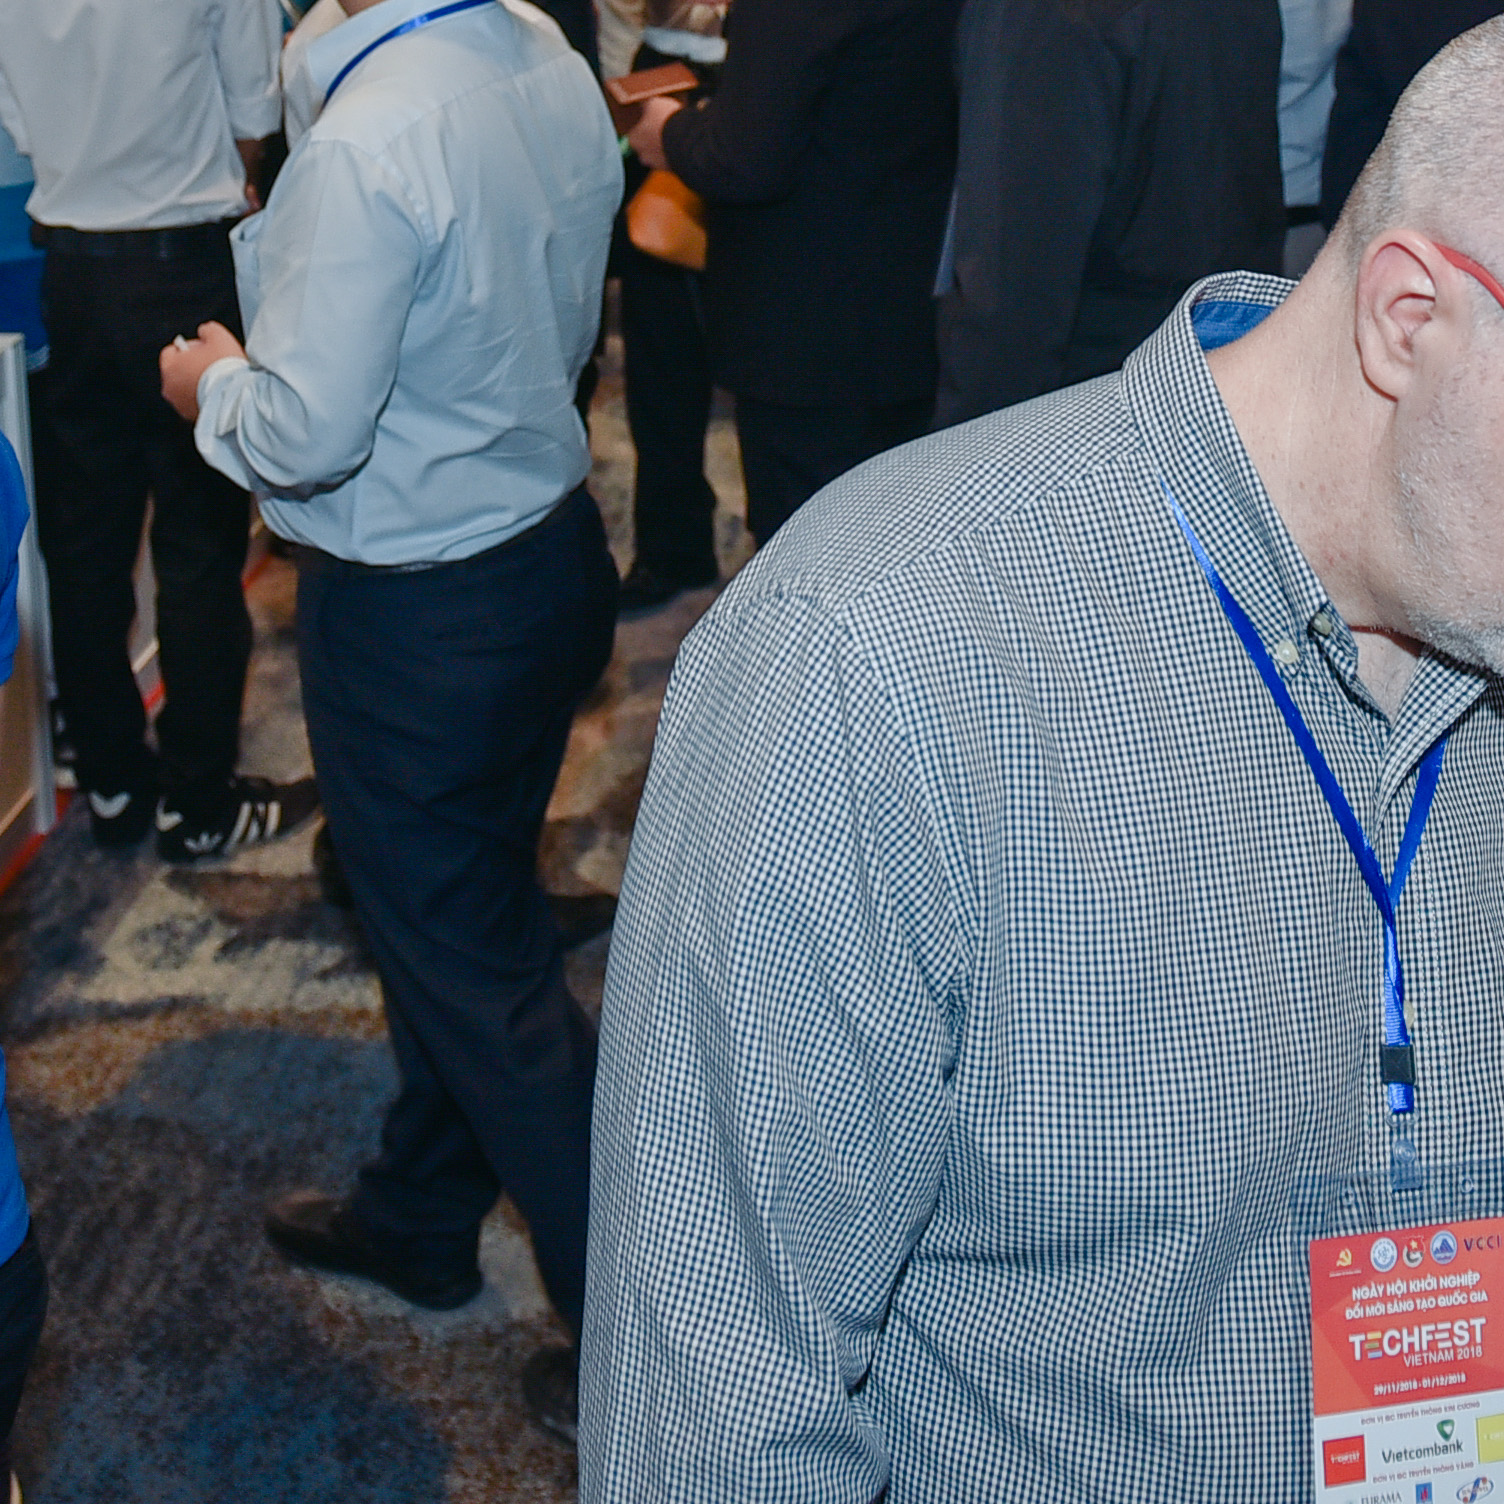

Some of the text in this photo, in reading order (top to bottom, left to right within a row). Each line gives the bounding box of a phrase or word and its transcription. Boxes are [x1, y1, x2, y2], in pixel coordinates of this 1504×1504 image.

[1463, 1234, 1502, 1252] VCCI
[1352, 1269, 1481, 1302] NGÀY HỘI KHỞI NGHIỆP
[1345, 1289, 1489, 1320] ĐỔI MỚI SÁNG TẠO QUỐC GIA
[1348, 1316, 1487, 1361] TECHFEST
[1403, 1344, 1483, 1368] VIETNAM 2018
[1381, 1439, 1464, 1465] Vietcombank
